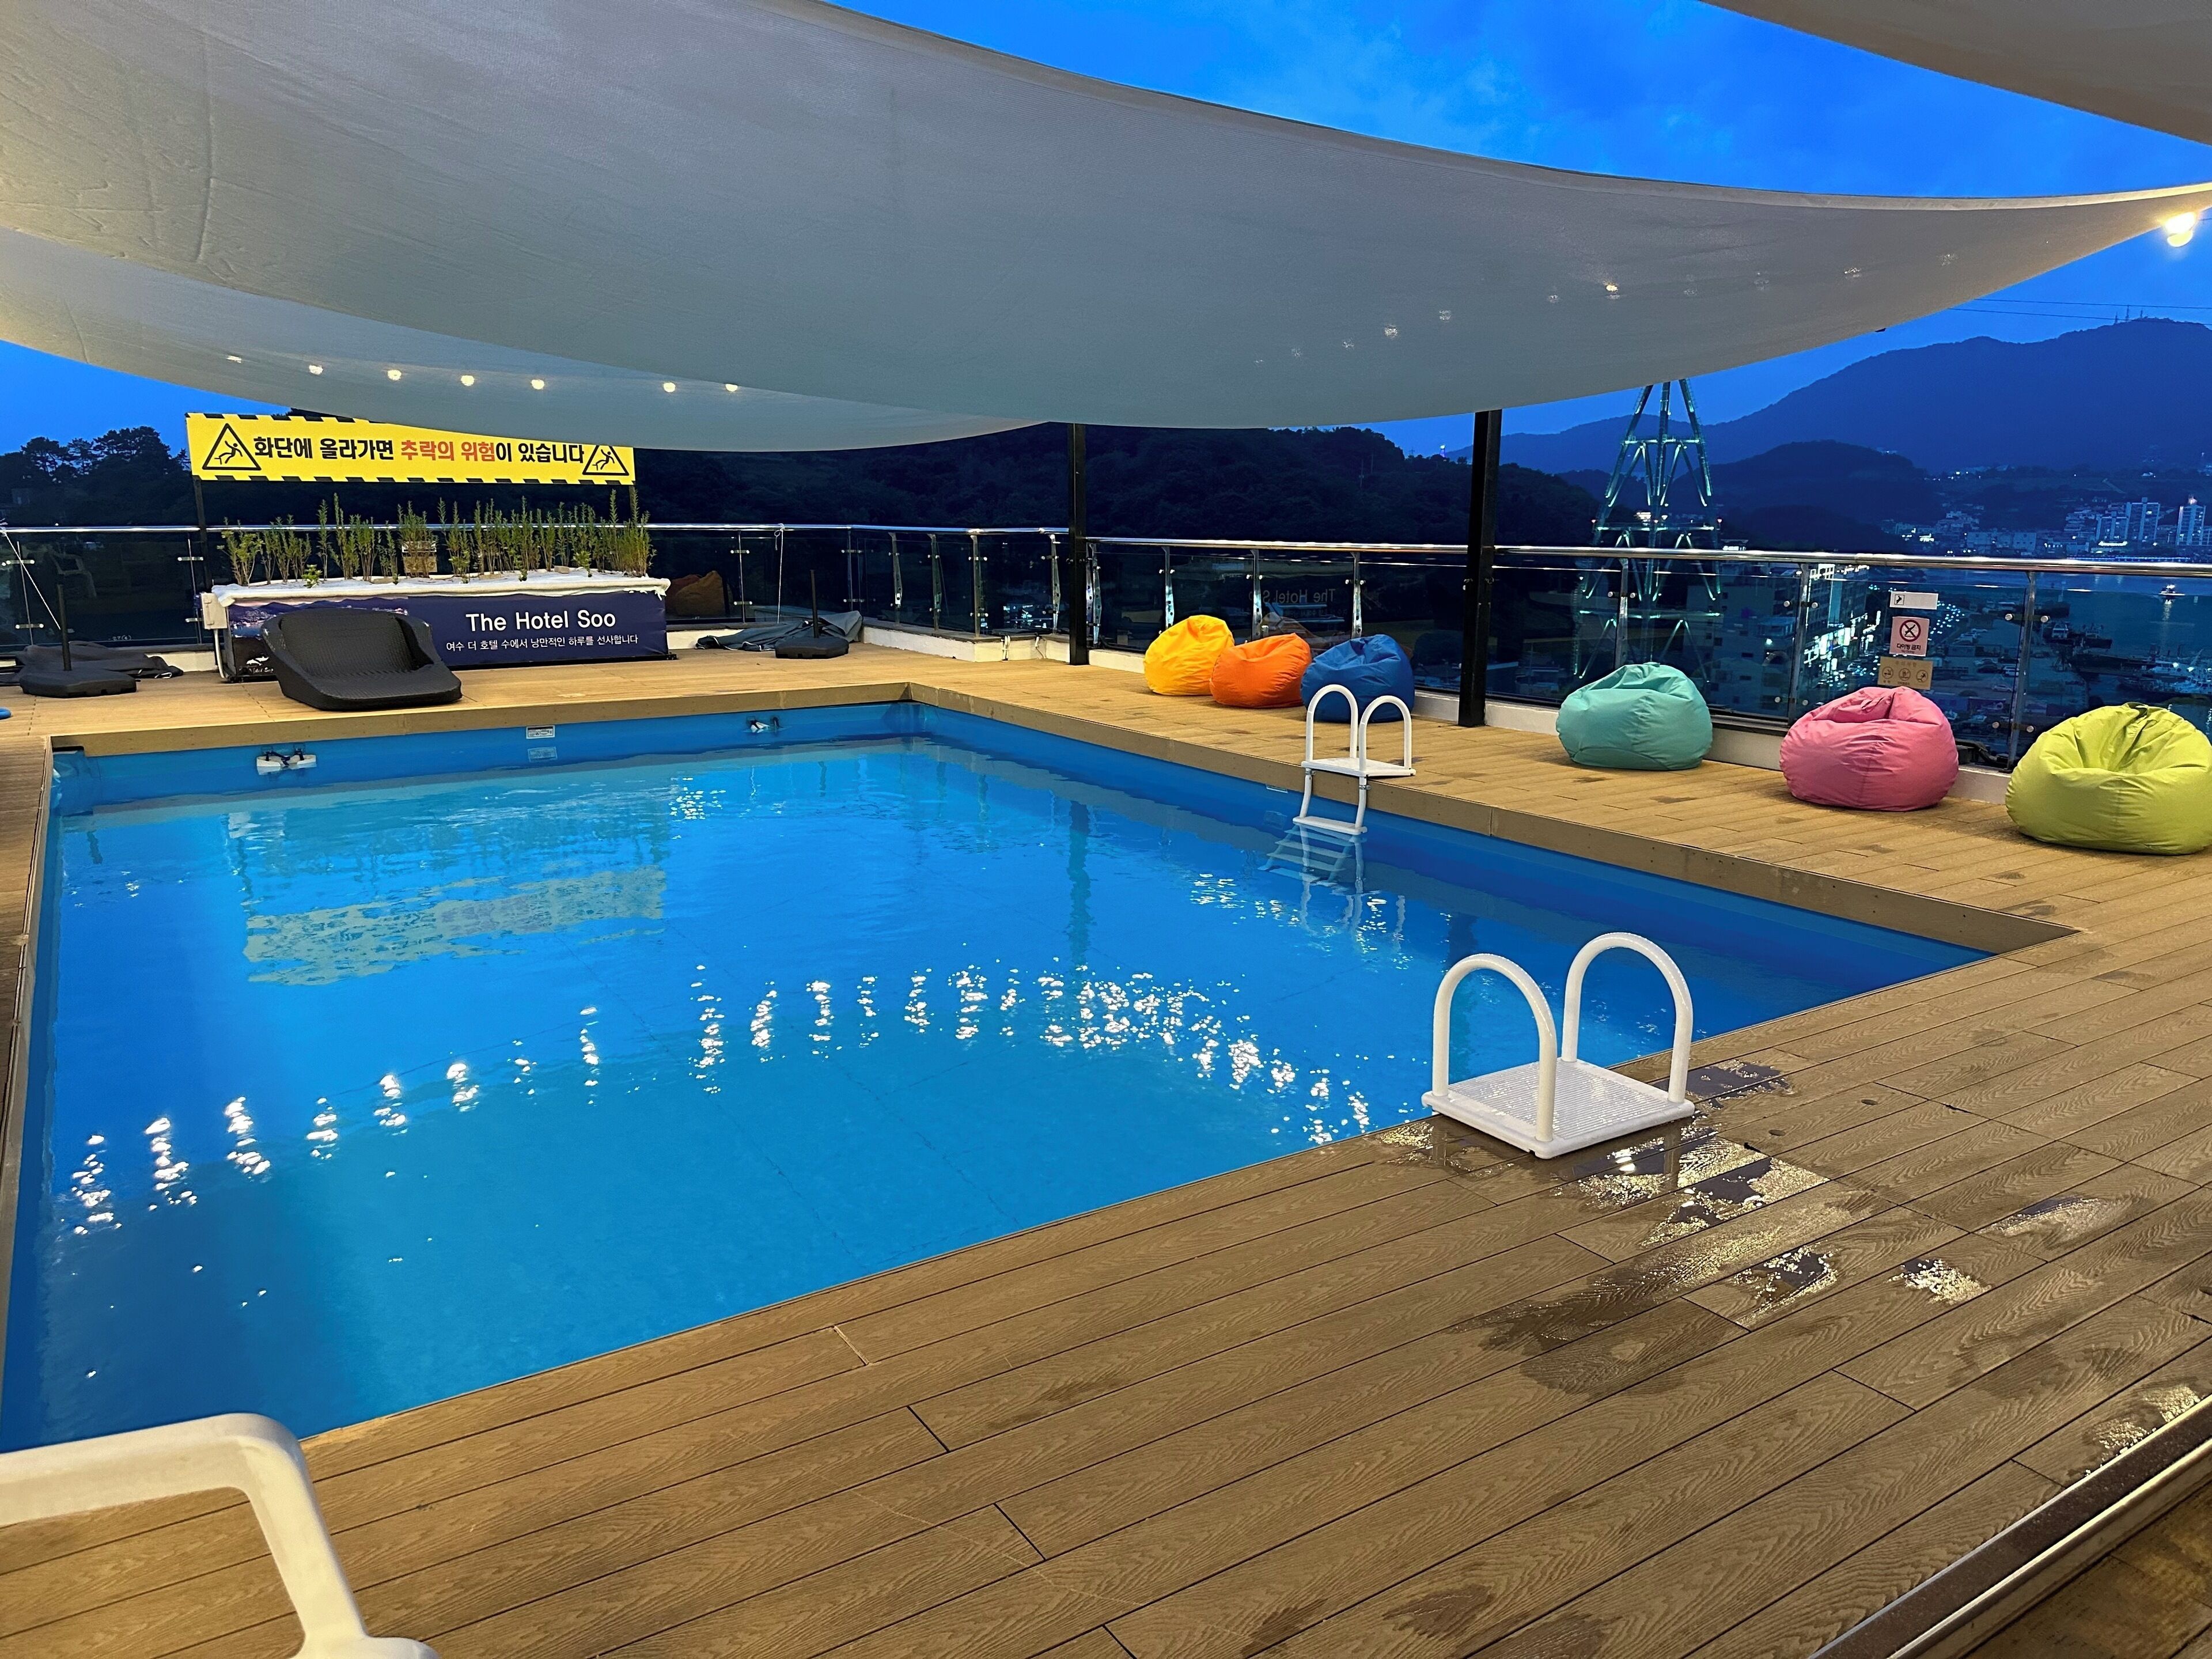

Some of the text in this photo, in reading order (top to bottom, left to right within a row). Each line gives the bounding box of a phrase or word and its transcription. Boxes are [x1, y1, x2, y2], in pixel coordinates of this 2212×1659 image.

[253, 436, 585, 464] 화단에 올라가면 추락의 위험이 있습니다
[465, 609, 616, 632] The Hotel Soo
[445, 634, 639, 652] 여수 더 호텔 수에서 낭만적인 하루를 선사합니다
